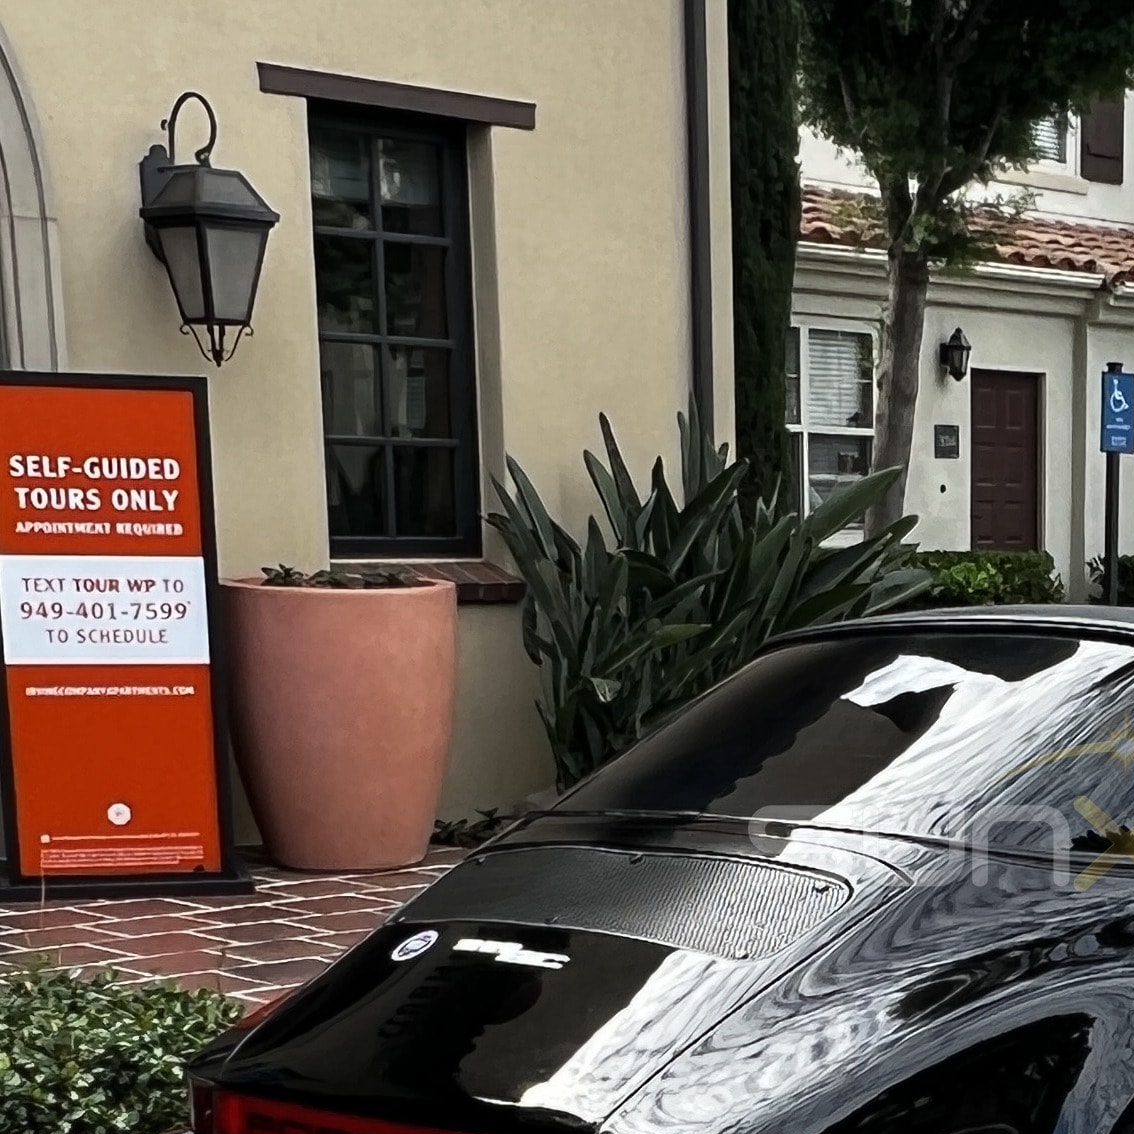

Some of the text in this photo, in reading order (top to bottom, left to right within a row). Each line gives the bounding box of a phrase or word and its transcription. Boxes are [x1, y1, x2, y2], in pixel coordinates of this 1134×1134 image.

[9, 455, 181, 480] SELF-GUIDED
[14, 487, 179, 511] TOURS ONLY
[15, 521, 183, 536] APPOINTMENT REQUIRED
[22, 578, 184, 593] TEXT TOUR WP TO
[20, 601, 188, 620] 949-401-7599
[46, 629, 169, 644] TO SCHEDULE
